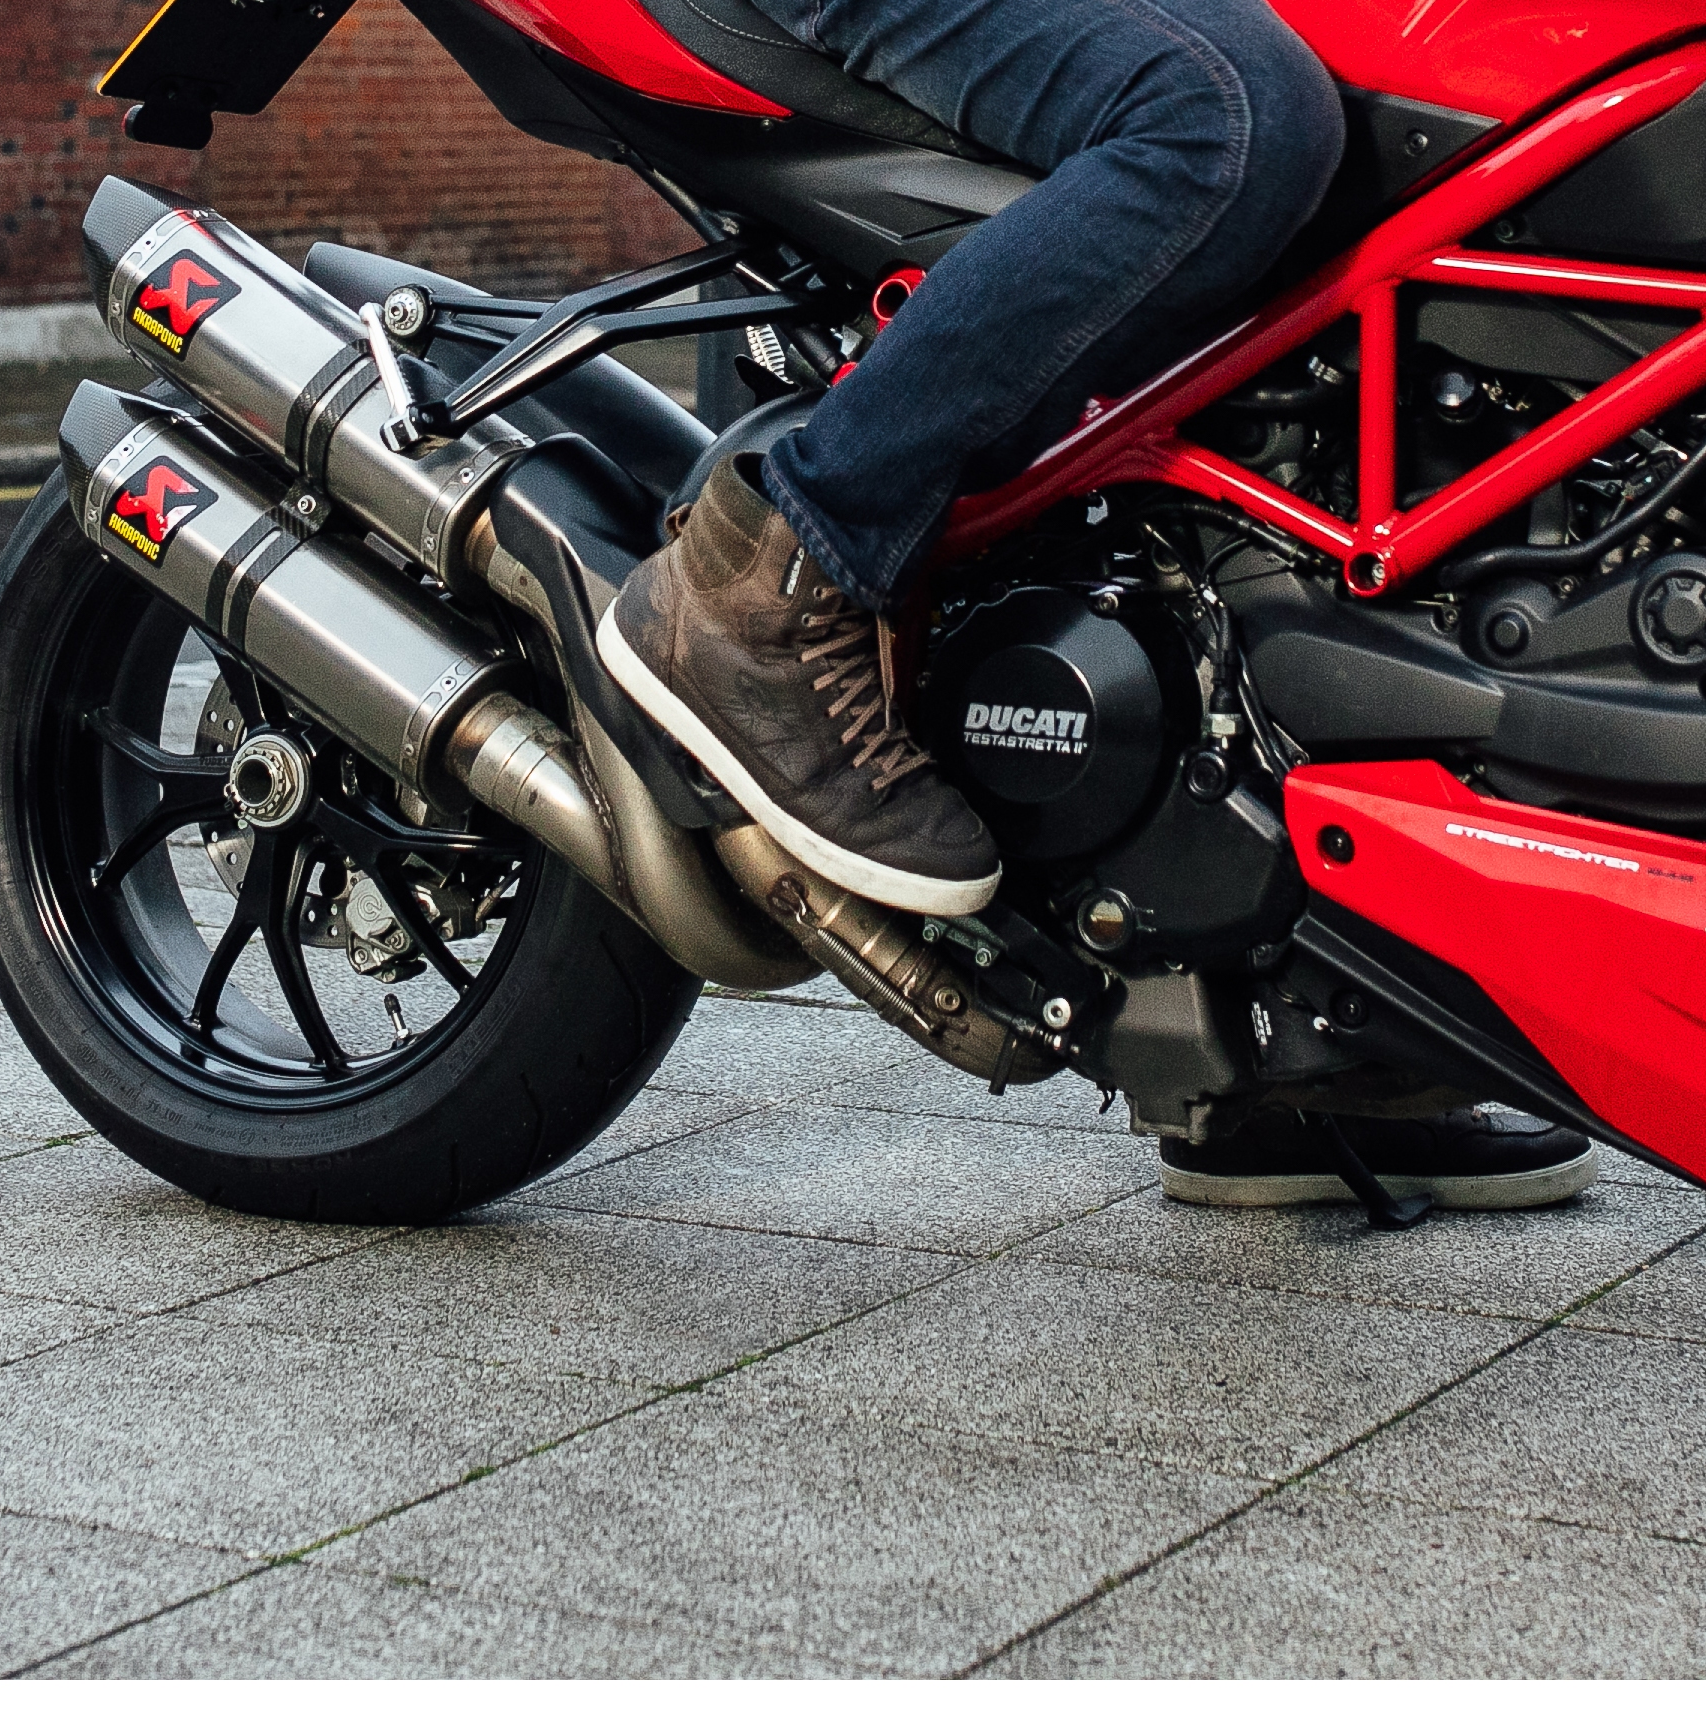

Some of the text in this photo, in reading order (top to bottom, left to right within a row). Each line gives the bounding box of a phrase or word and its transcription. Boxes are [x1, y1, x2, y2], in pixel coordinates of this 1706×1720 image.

[965, 703, 1087, 738] DUCATI
[964, 732, 1071, 754] TESTASTRETTA
[1445, 823, 1640, 872] STREETFIGHTER
